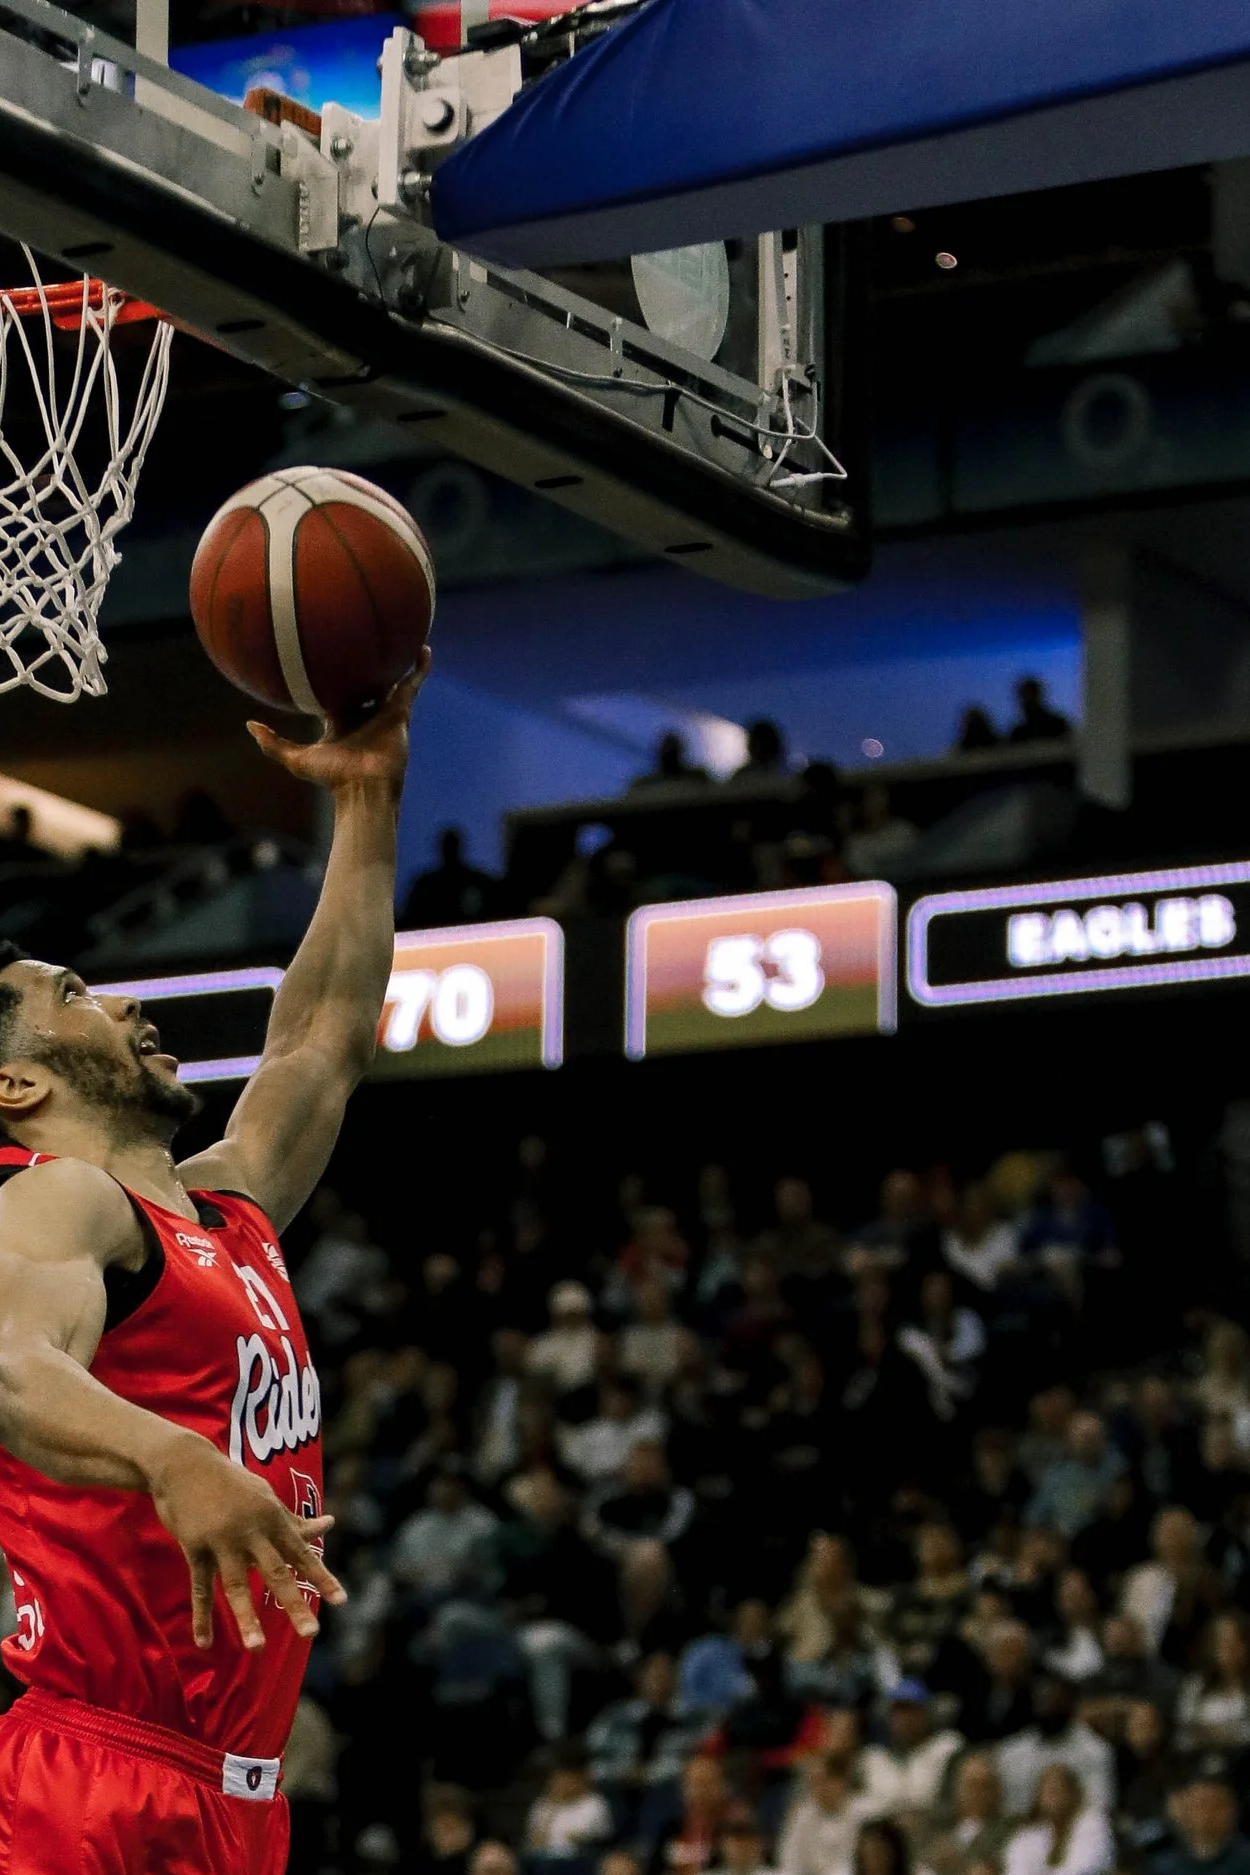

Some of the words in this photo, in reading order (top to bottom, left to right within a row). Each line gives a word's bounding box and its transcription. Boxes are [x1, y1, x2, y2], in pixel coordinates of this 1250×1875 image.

[702, 928, 825, 1017] 53
[1007, 894, 1237, 968] EAGLES
[384, 963, 494, 1052] 70
